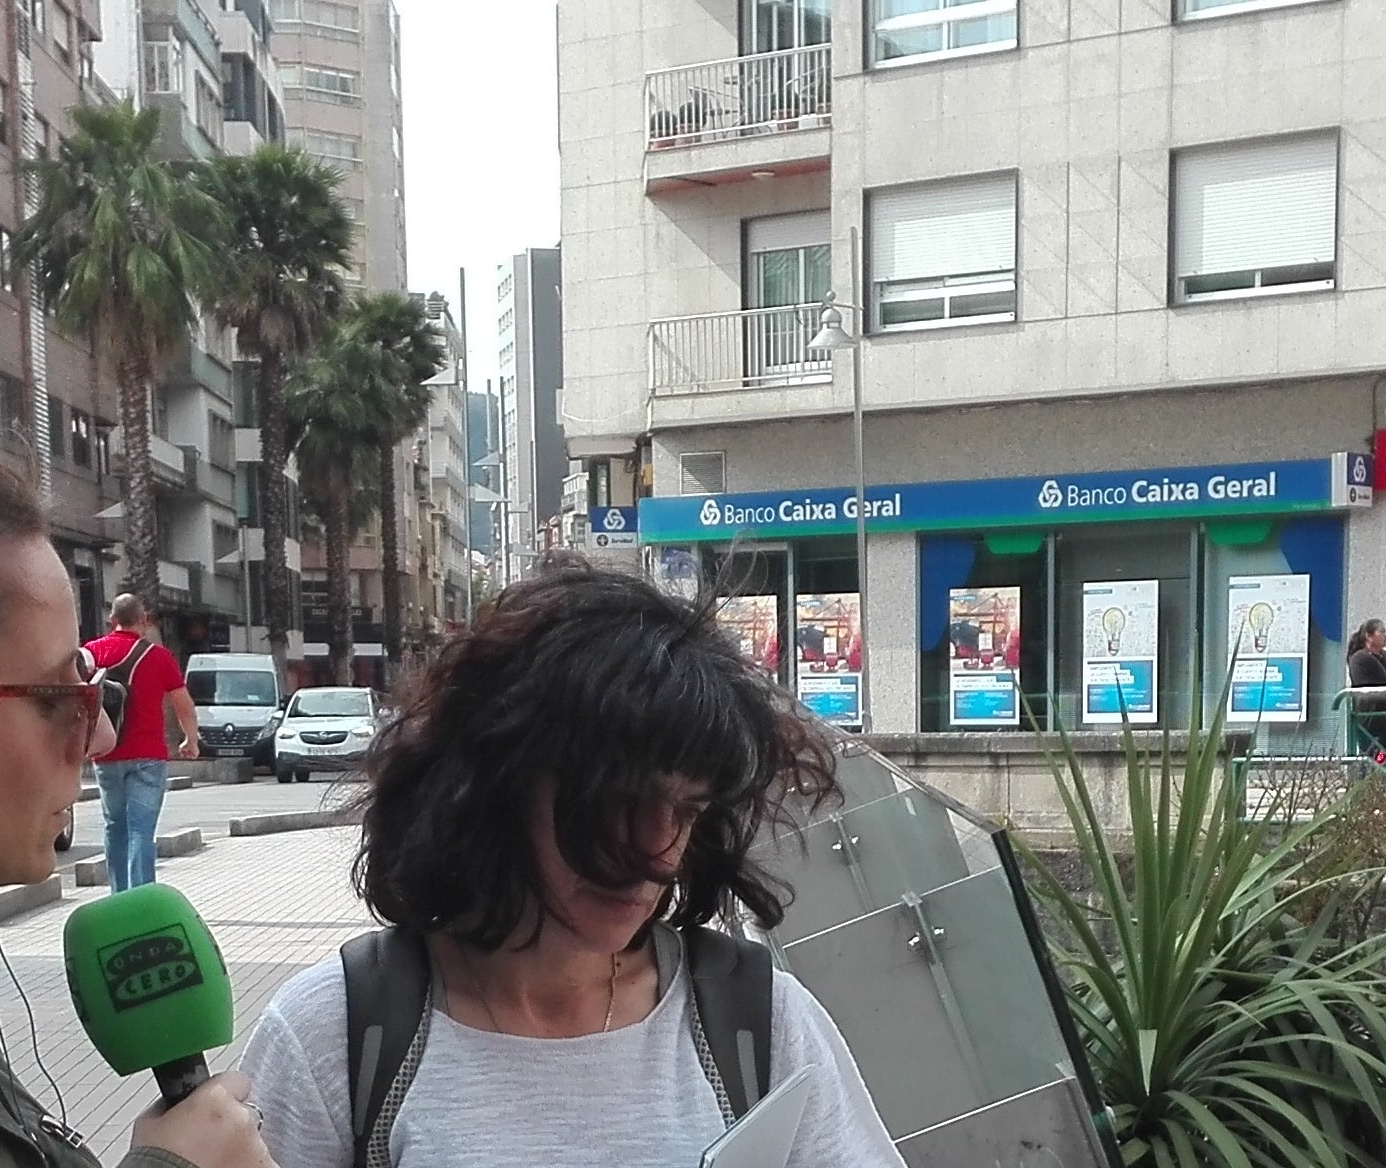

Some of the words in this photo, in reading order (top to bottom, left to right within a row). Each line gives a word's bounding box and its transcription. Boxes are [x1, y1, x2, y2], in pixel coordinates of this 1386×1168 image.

[1068, 485, 1127, 507] Banco
[1131, 478, 1199, 502] Caixa
[1207, 471, 1277, 499] Geral
[724, 504, 775, 524] Banco
[779, 499, 837, 522] Caixa
[842, 493, 901, 518] Geral
[124, 964, 187, 994] CERO
